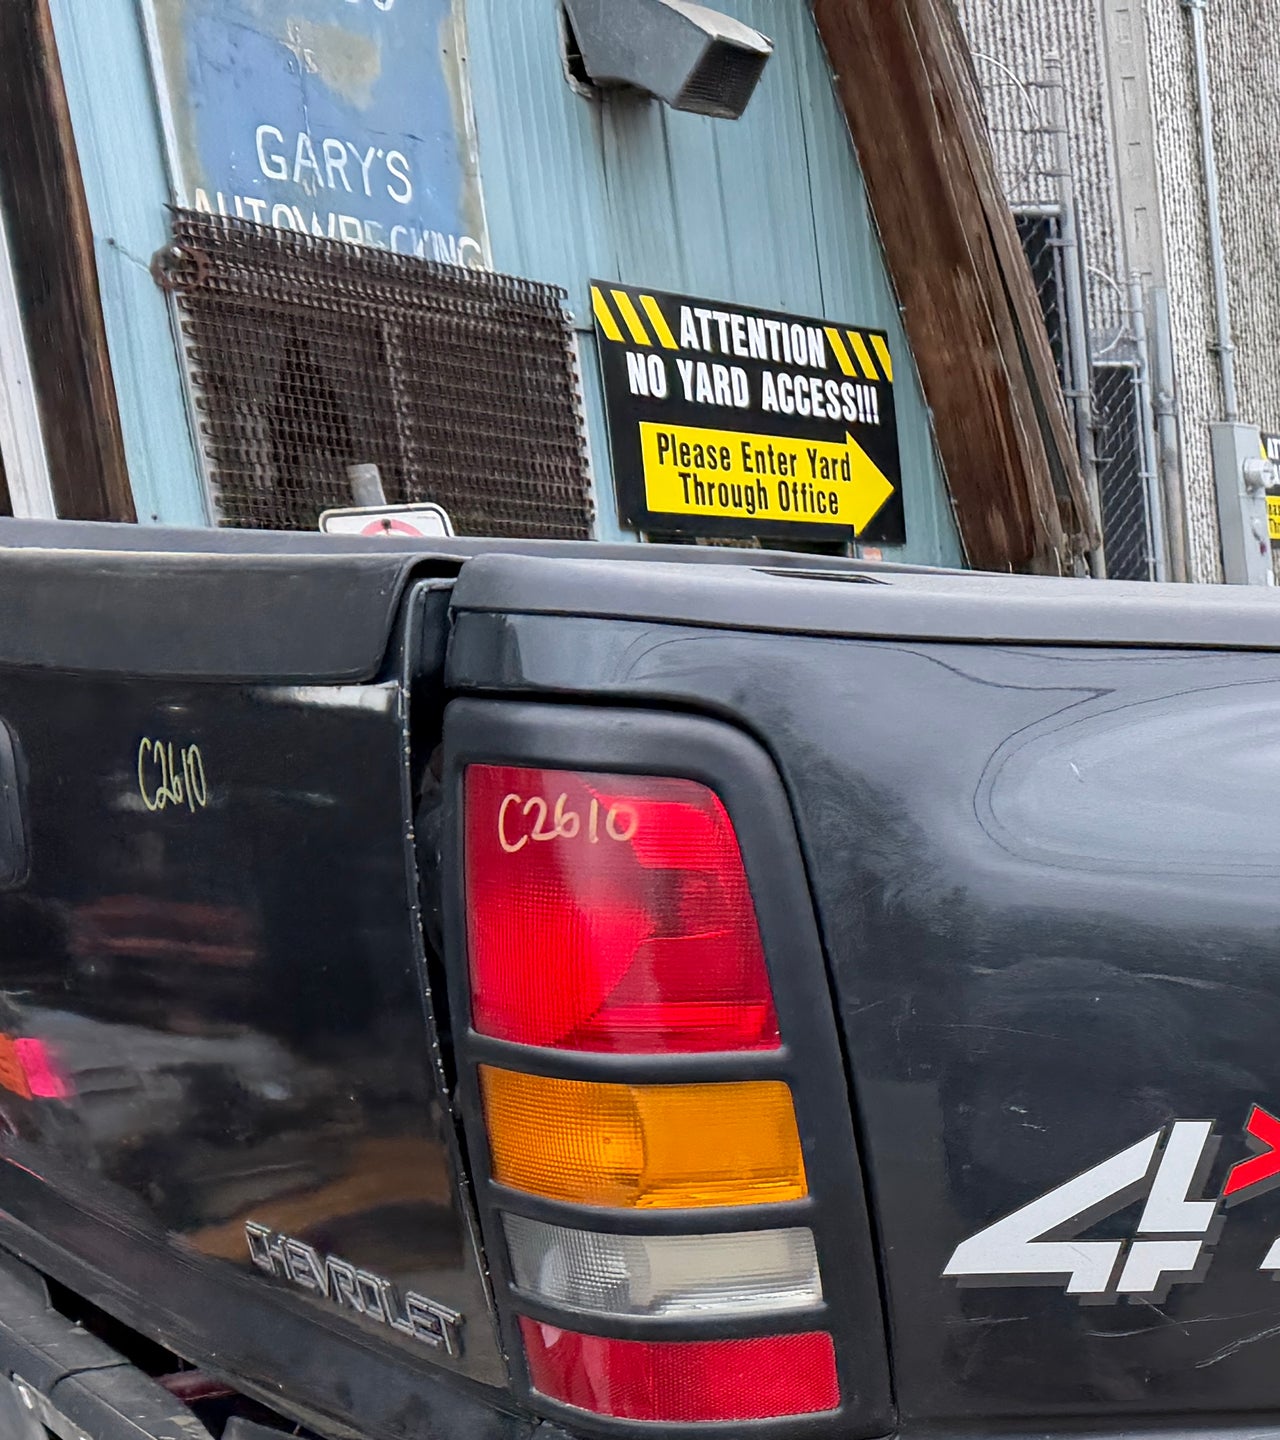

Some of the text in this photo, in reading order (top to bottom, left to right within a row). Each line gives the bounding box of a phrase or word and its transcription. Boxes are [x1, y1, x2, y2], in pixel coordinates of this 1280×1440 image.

[255, 124, 413, 204] GARY'S
[680, 305, 828, 370] ATTENTION
[626, 351, 881, 426] NO YARD ACCESS!!!
[656, 432, 851, 482] Please Enter Yard
[678, 471, 839, 515] Through Office
[138, 737, 206, 813] C2610
[498, 793, 638, 853] C2610
[246, 1220, 461, 1355] CHEVROLET
